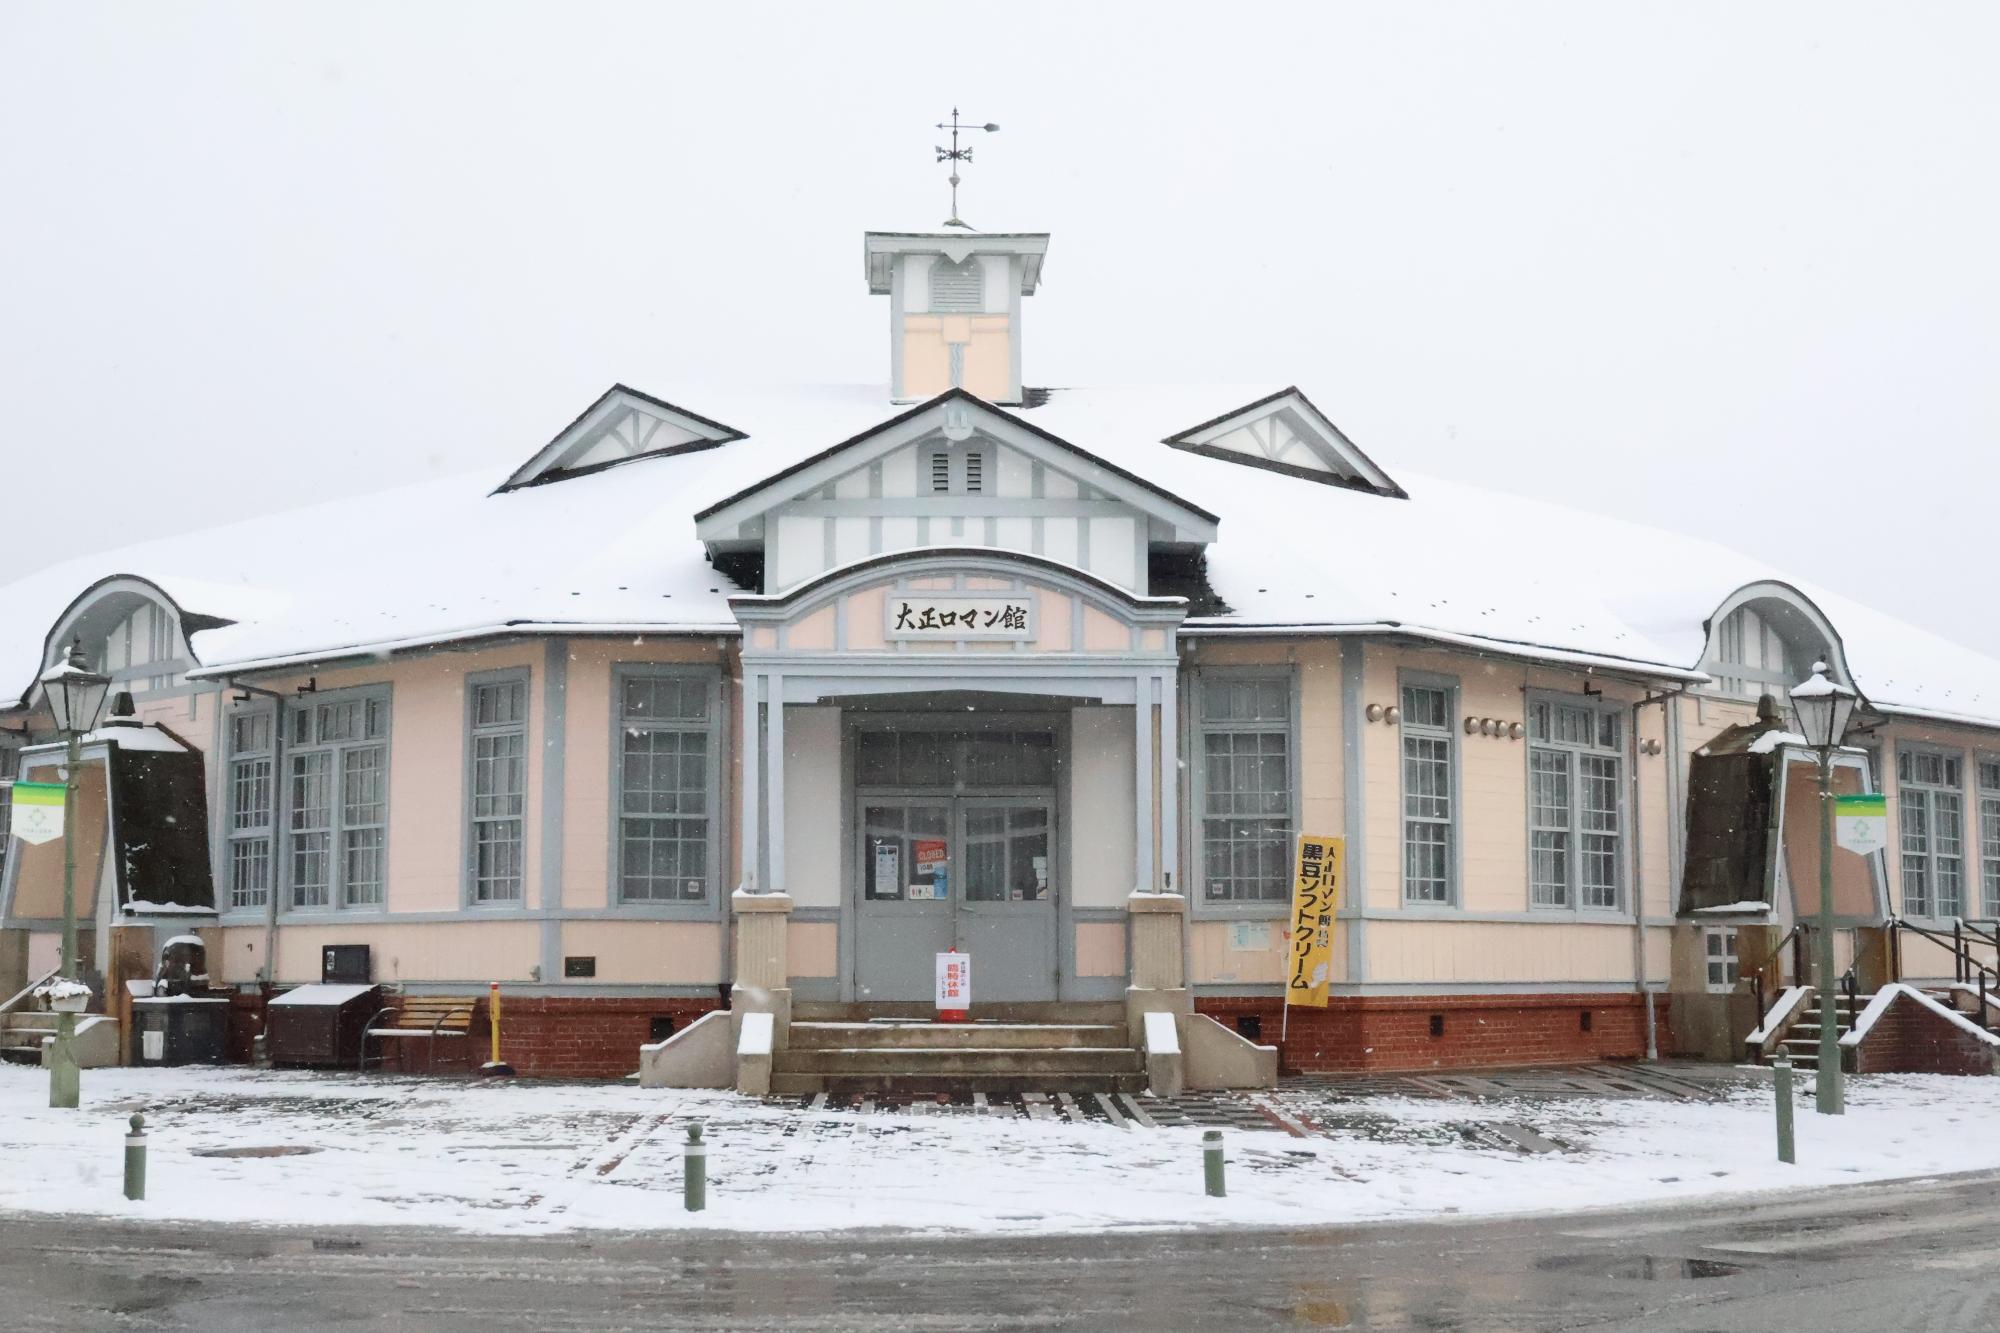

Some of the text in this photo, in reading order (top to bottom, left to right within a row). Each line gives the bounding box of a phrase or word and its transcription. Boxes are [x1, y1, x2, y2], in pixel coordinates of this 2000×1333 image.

[895, 602, 1027, 630] 大正ロマン館
[1291, 843, 1323, 989] 黒豆ソフトクリーム
